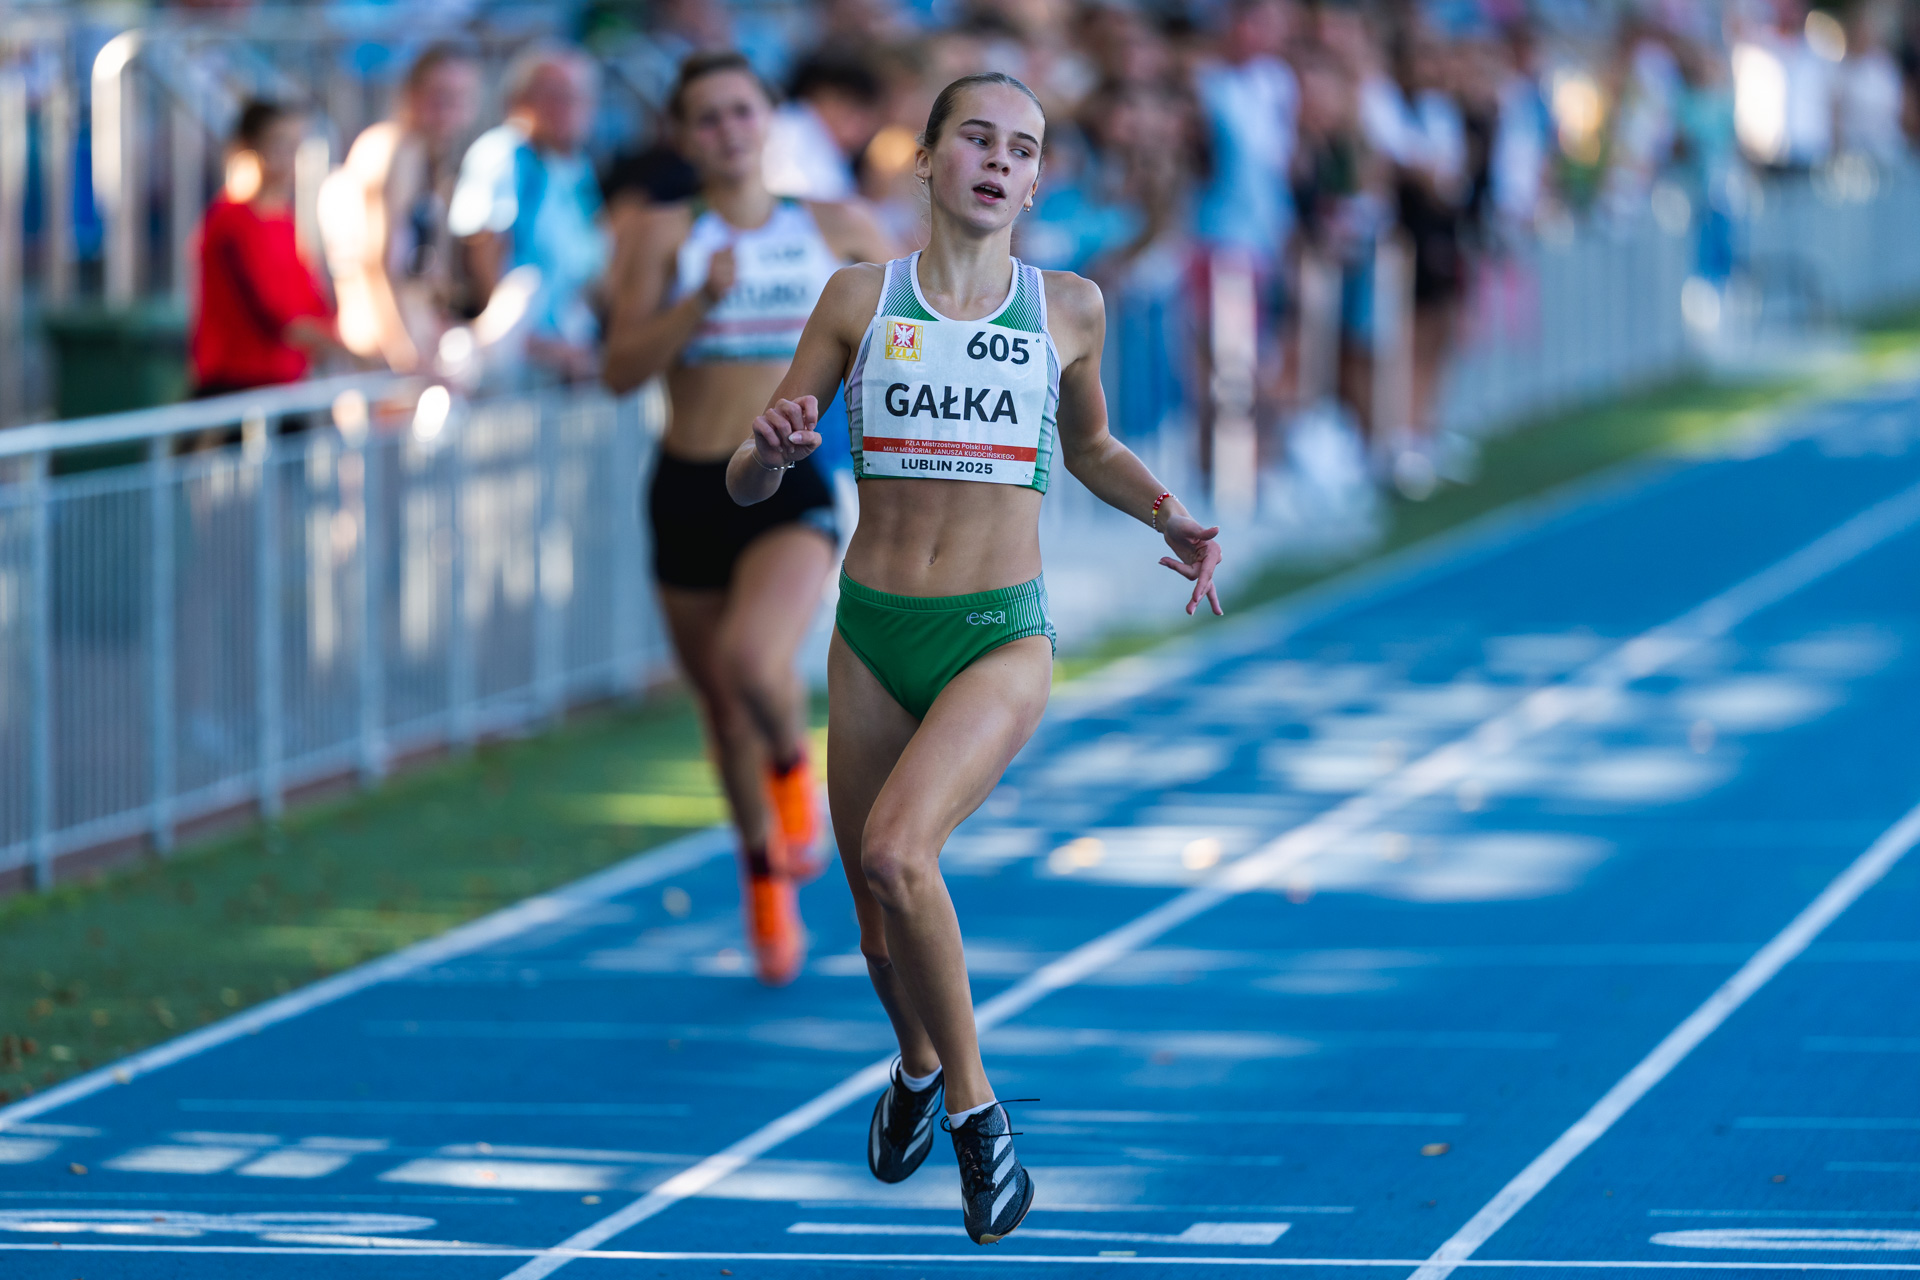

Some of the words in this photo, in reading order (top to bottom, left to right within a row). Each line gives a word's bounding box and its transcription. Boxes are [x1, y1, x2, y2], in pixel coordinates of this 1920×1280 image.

[887, 346, 919, 360] PZLA
[967, 331, 1030, 365] 605
[885, 382, 1018, 425] GAŁKA
[921, 440, 960, 449] Mistrzostwa
[899, 446, 932, 454] MEMORIAŁ
[933, 448, 963, 456] JANUSZA
[964, 450, 1015, 460] KUSOCIŃSKIEGO
[901, 458, 952, 471] LUBLIN
[955, 461, 993, 474] 2025
